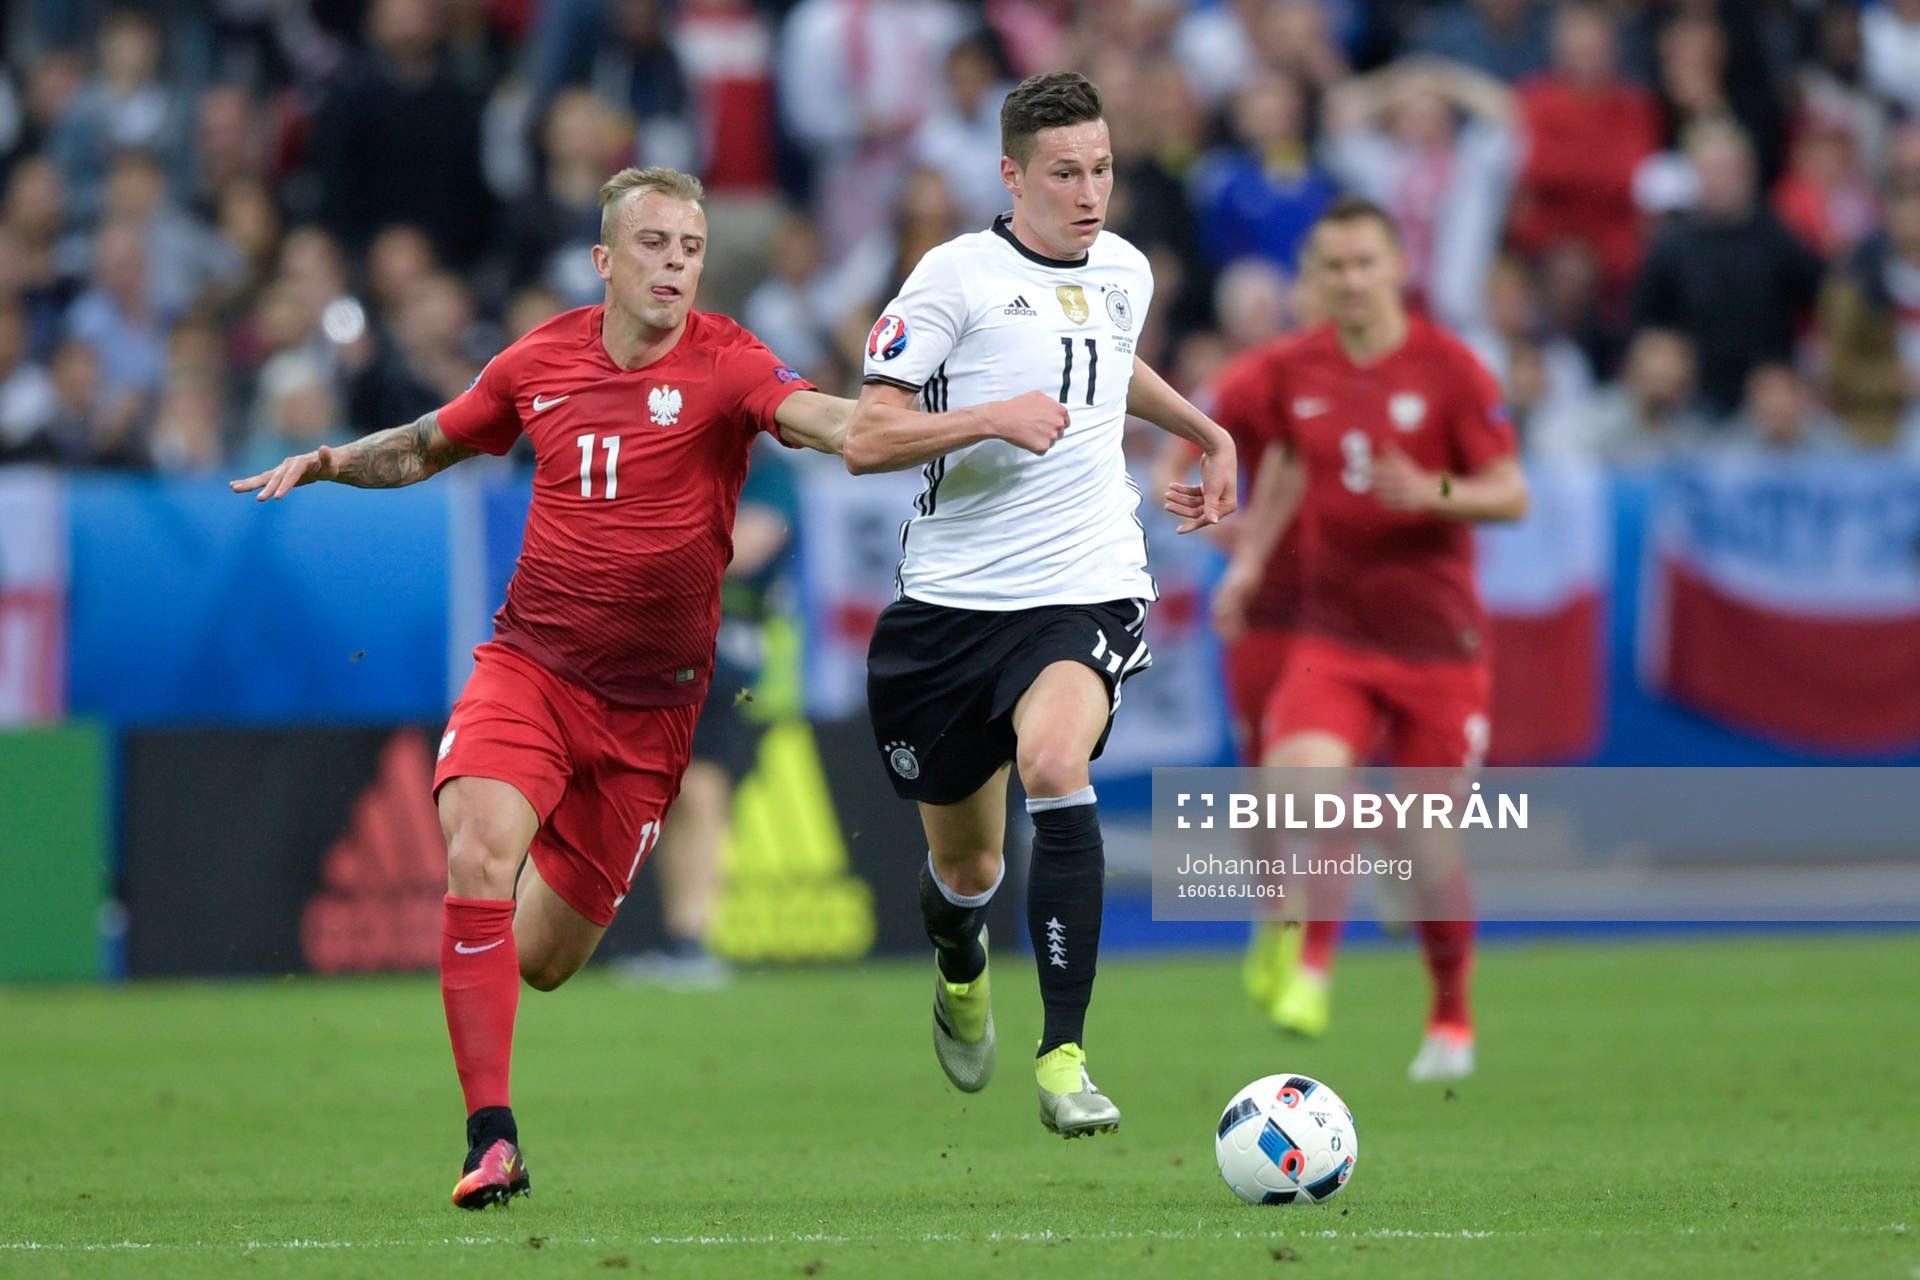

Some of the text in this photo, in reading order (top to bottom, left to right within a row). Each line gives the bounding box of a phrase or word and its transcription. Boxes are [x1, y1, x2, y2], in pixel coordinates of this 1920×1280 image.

[1004, 307, 1037, 316] adidas
[1059, 337, 1098, 405] 11
[577, 434, 621, 499] 11
[1091, 629, 1123, 673] 11
